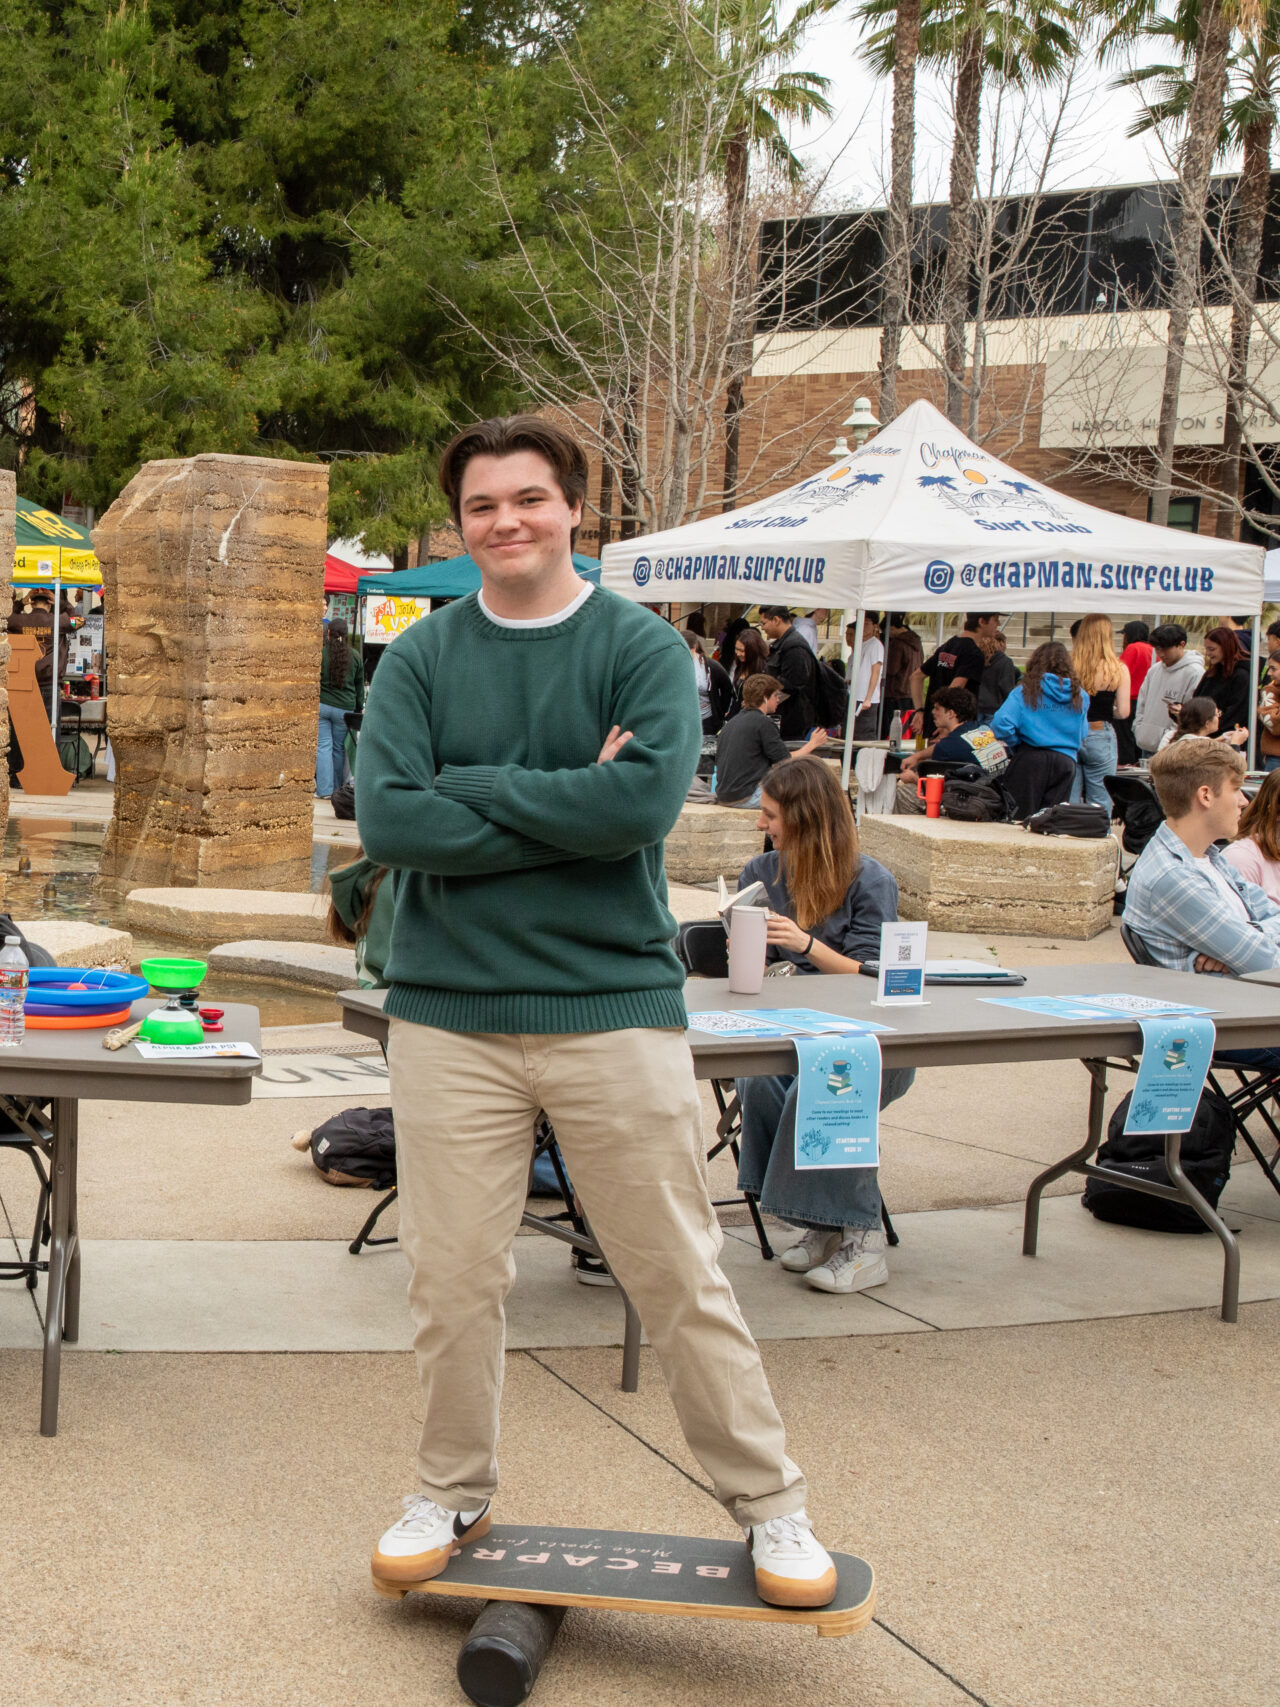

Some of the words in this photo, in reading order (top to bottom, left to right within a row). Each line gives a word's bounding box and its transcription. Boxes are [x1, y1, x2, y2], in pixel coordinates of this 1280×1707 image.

[724, 518, 765, 530] Surf
[766, 516, 808, 528] Club
[974, 519, 1031, 533] Surf
[1031, 520, 1093, 534] Club
[491, 1537, 530, 1549] fun
[537, 1539, 604, 1552] sports
[612, 1546, 673, 1559] Make
